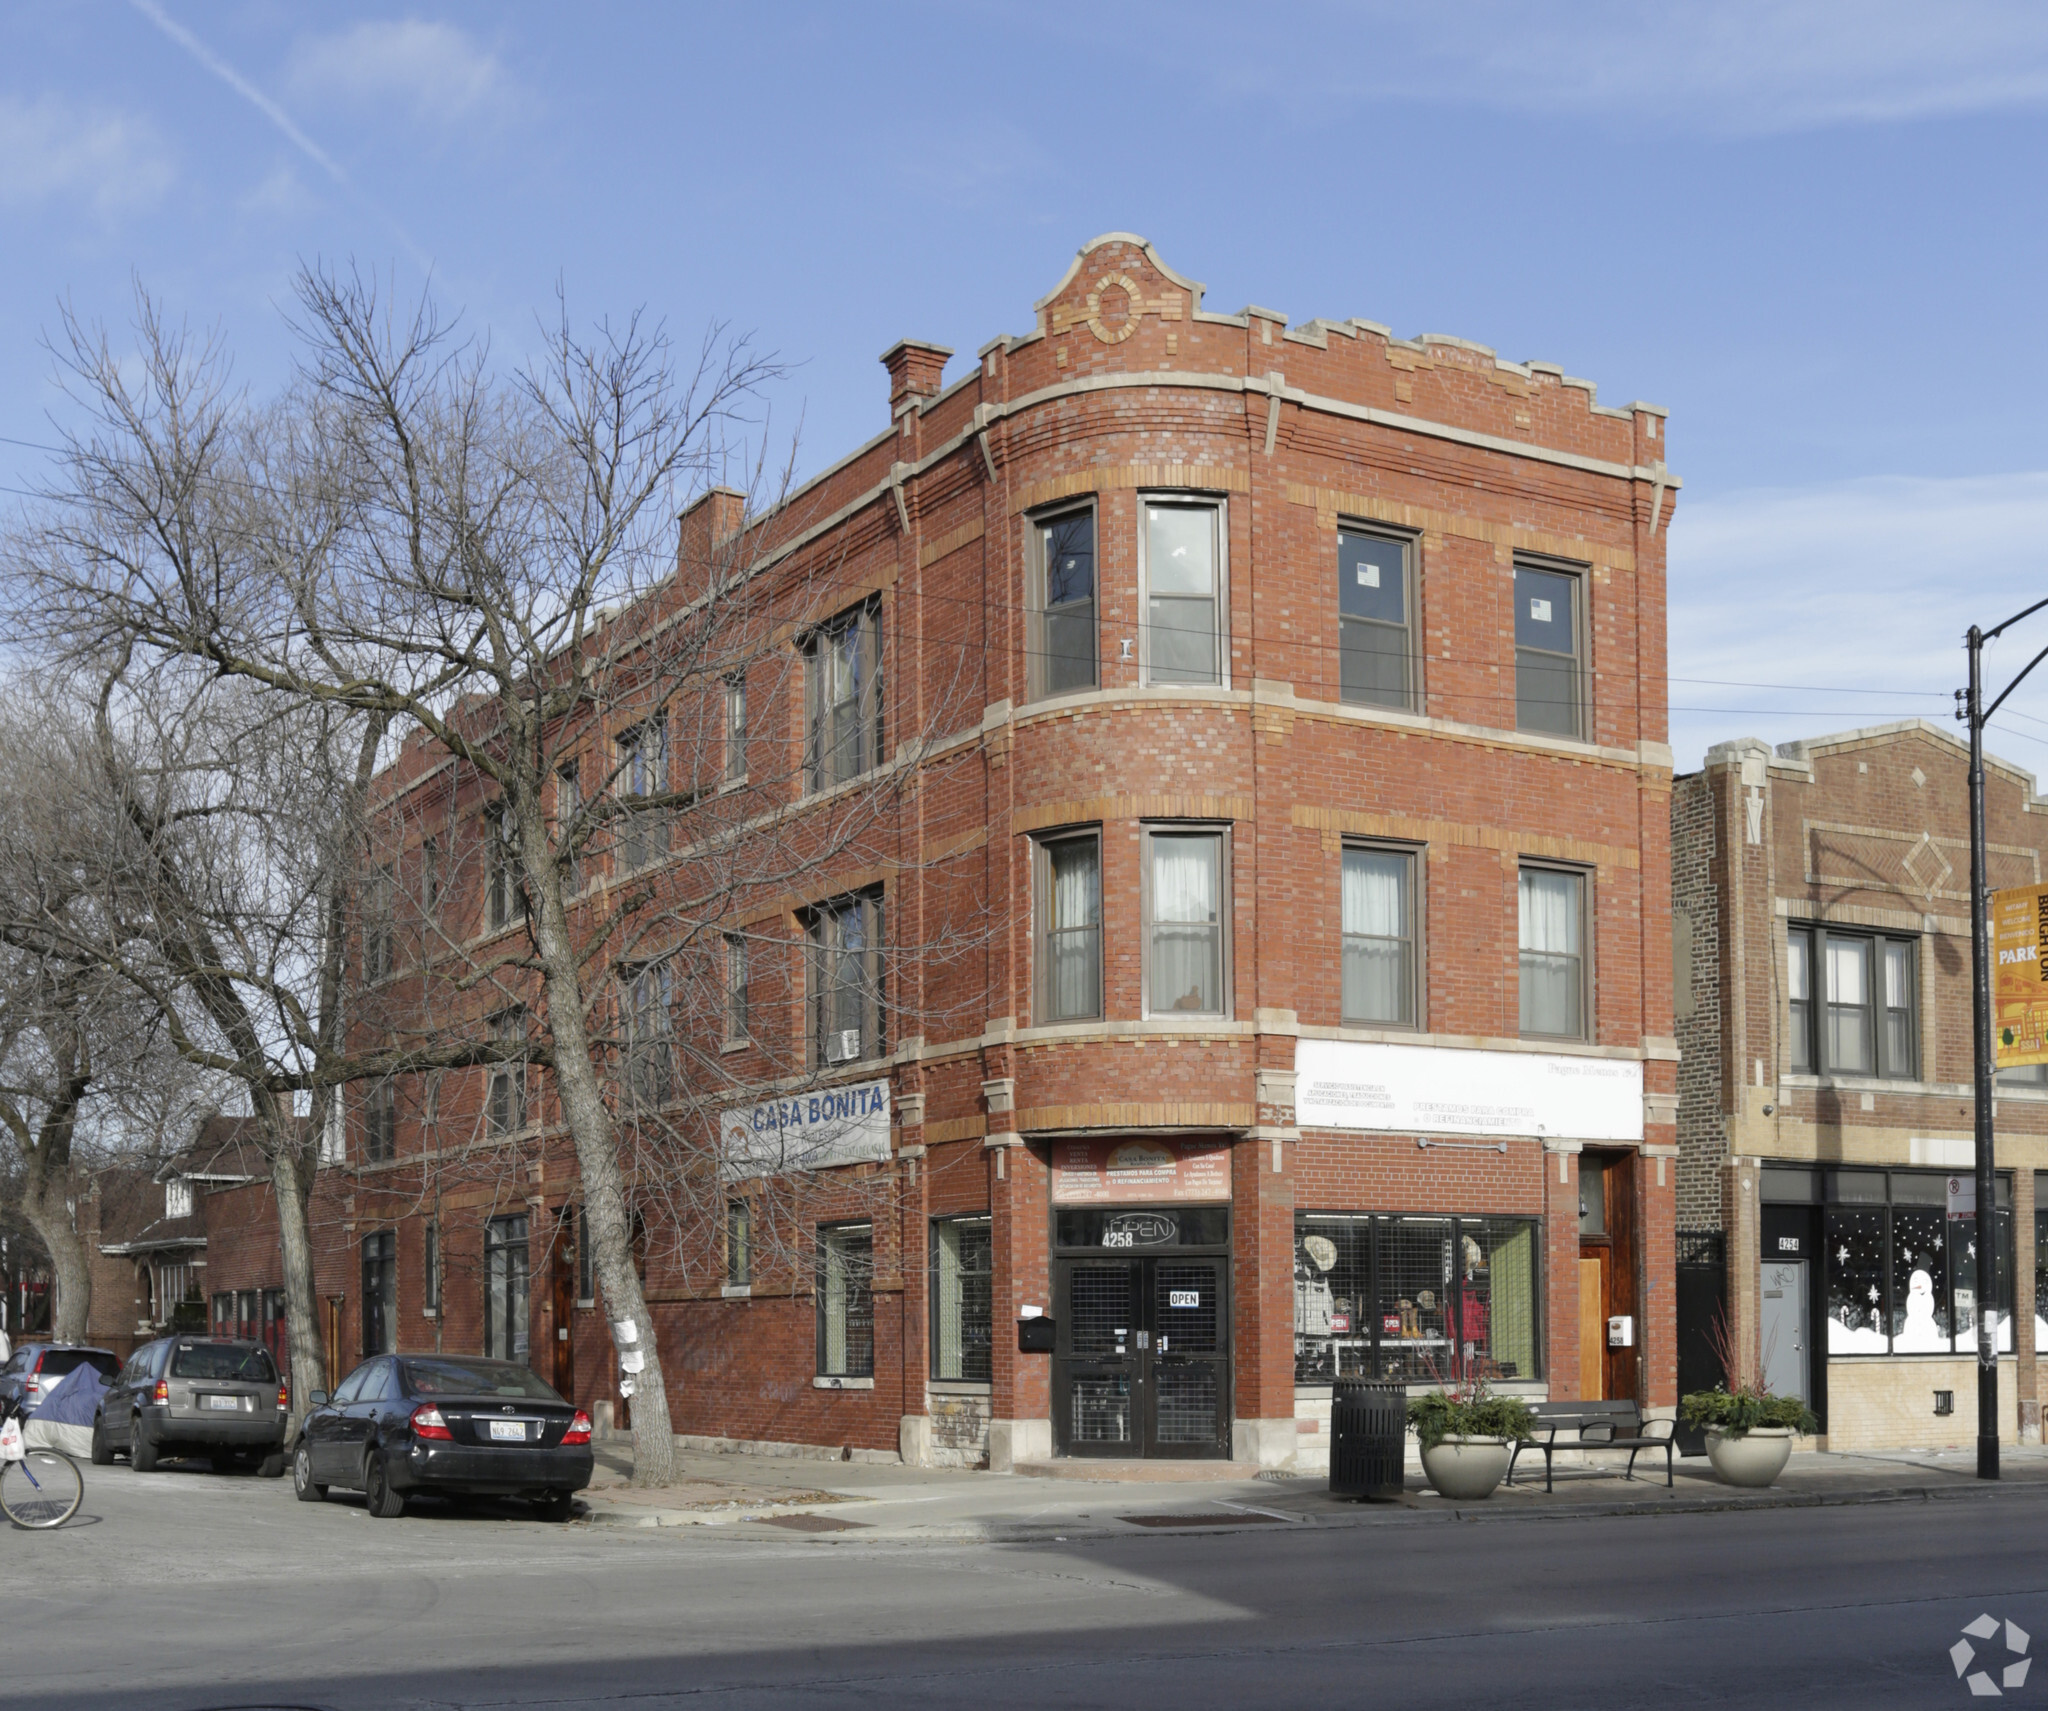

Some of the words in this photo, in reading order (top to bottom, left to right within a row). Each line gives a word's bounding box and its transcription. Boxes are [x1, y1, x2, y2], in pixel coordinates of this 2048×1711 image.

[2002, 914, 2032, 926] WELCOME
[1999, 944, 2038, 966] PARK
[754, 1101, 802, 1132] CASA
[809, 1086, 883, 1124] BONITA
[1413, 1102, 1469, 1114] PRESTAMOS
[1470, 1105, 1496, 1115] PARA
[1496, 1106, 1534, 1117] COMPRA
[1102, 1232, 1133, 1248] 4258
[1780, 1238, 1798, 1250] 4254
[1171, 1293, 1197, 1305] OPEN
[1331, 1319, 1346, 1328] PEN
[1384, 1319, 1399, 1328] OPEN
[1610, 1337, 1624, 1345] 4258
